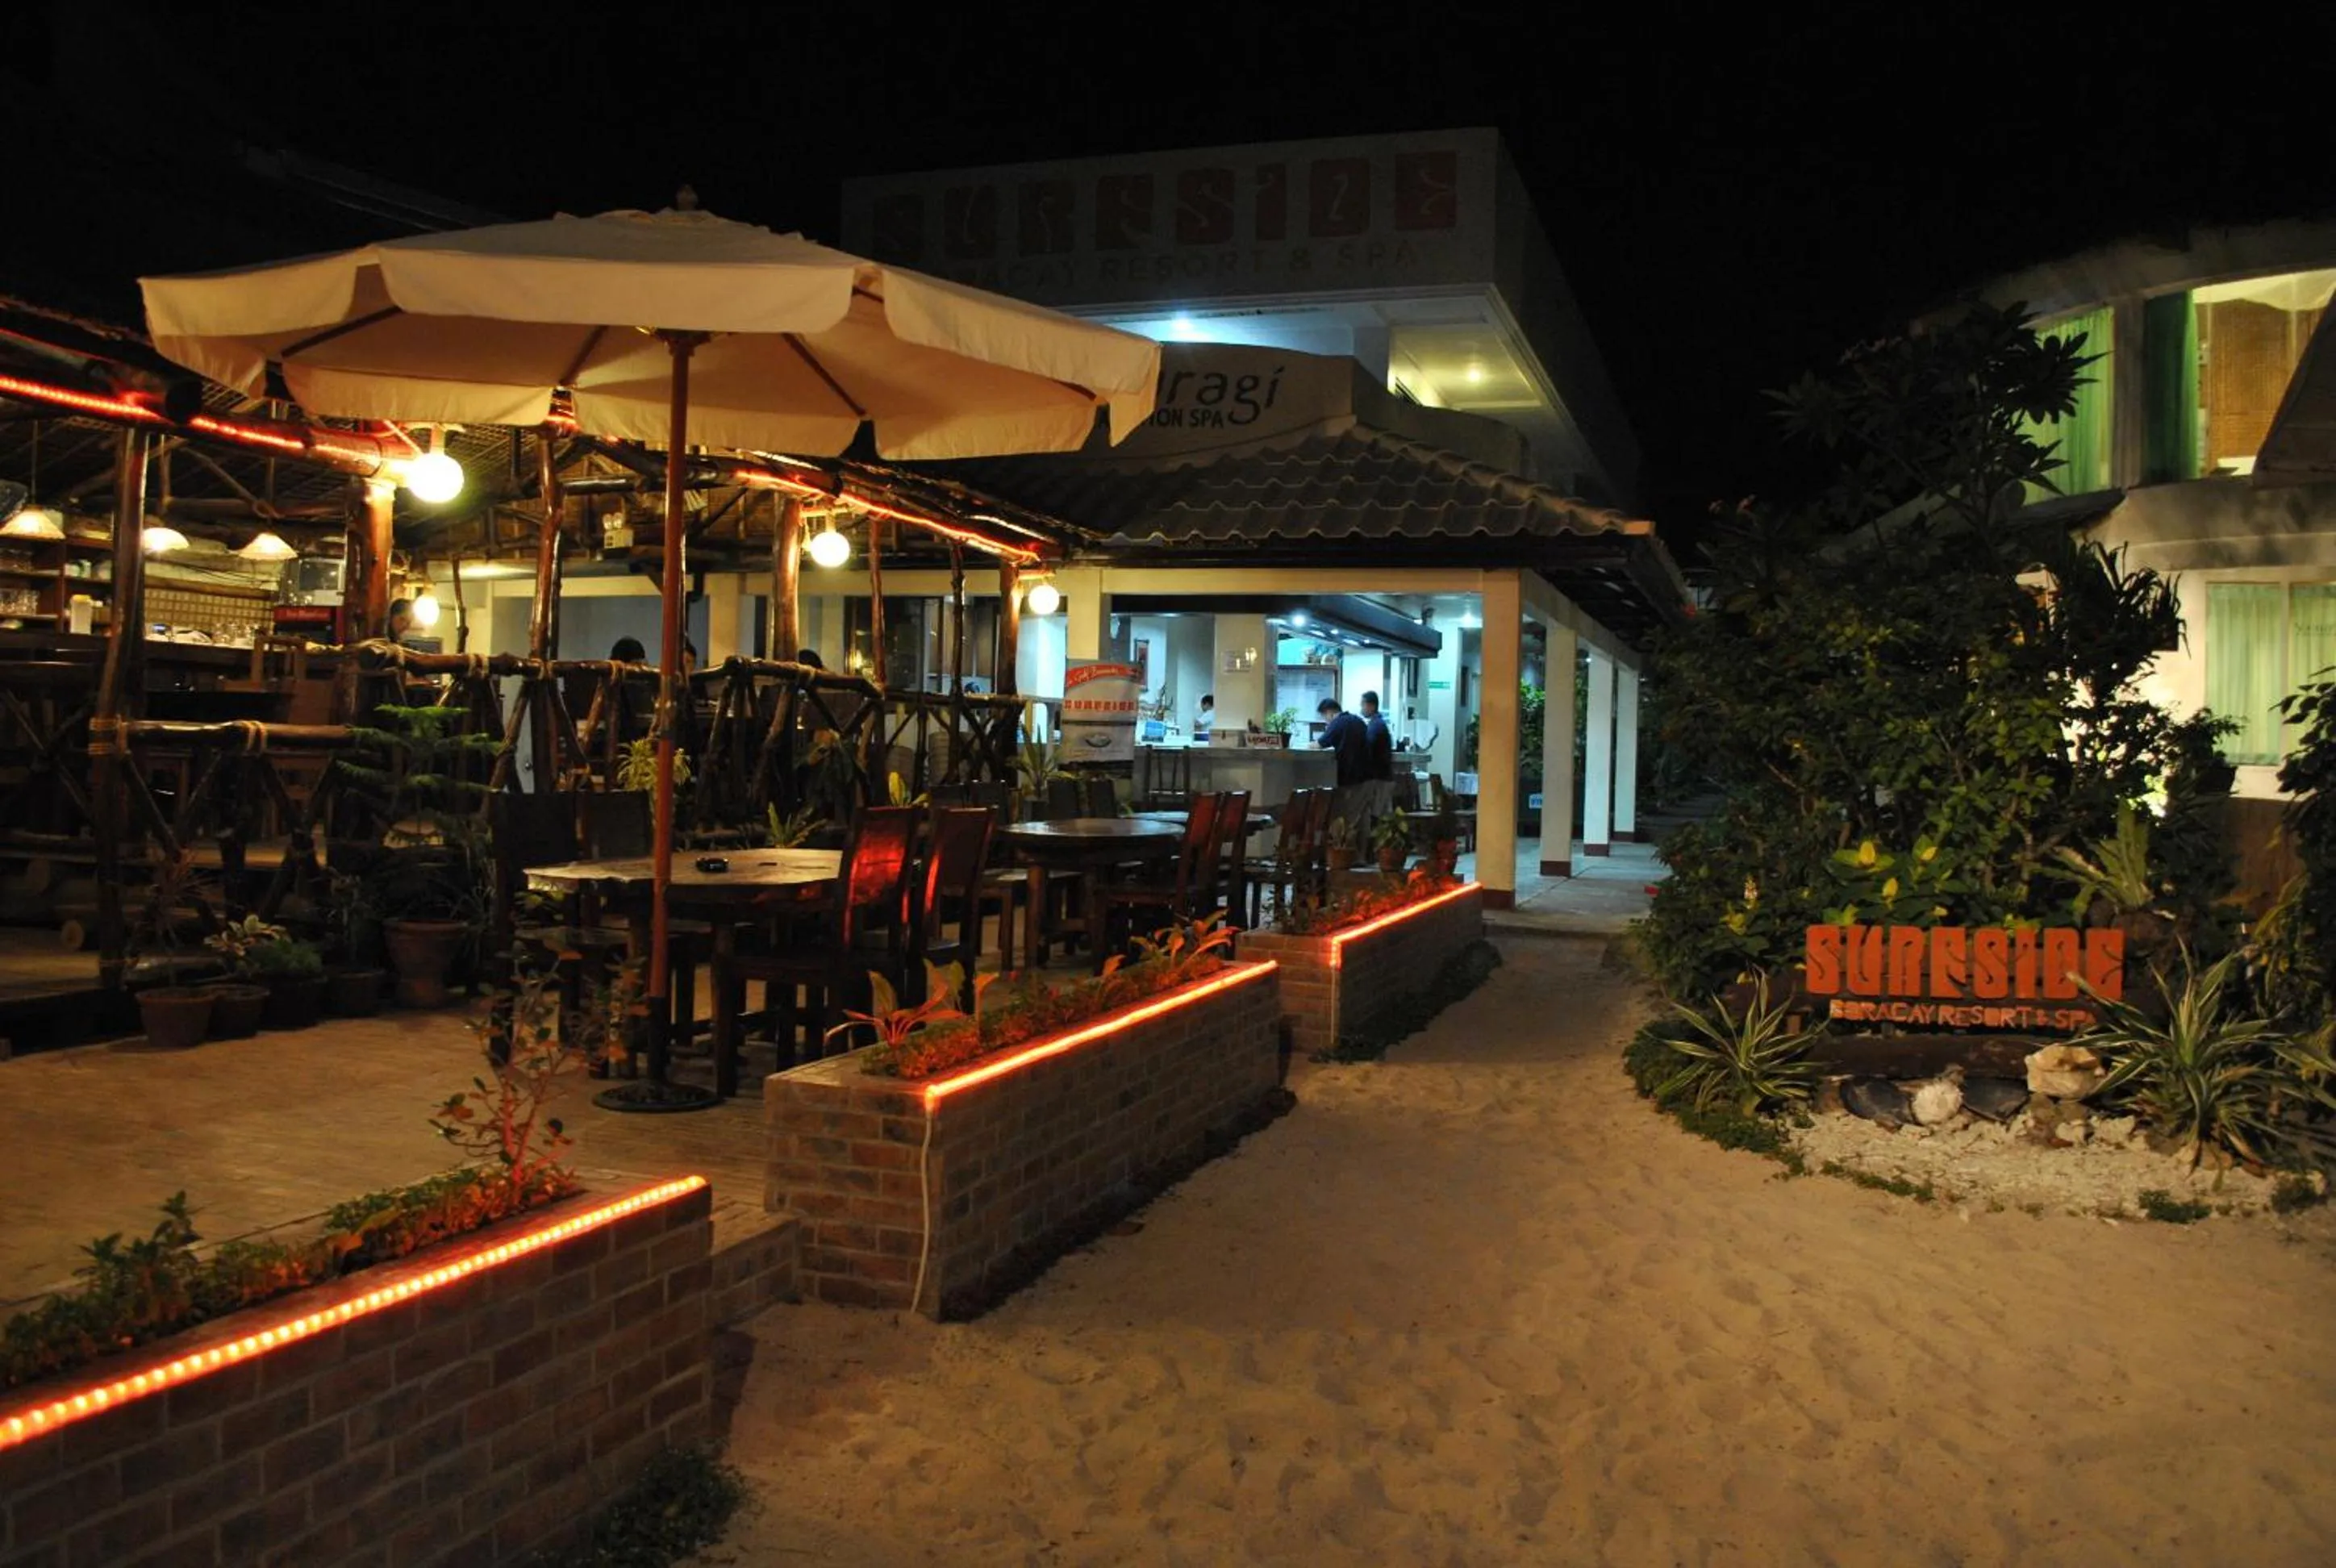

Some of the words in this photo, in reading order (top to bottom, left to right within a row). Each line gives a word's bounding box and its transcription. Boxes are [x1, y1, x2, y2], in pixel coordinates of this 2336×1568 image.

[1099, 248, 1264, 282] RESORT
[1290, 247, 1312, 270] &
[1337, 240, 1419, 269] SPA
[1157, 366, 1284, 424] ragi
[1188, 409, 1224, 428] SPA
[1805, 924, 2125, 999] SURFSIDE
[1938, 1004, 2034, 1029] RESORT
